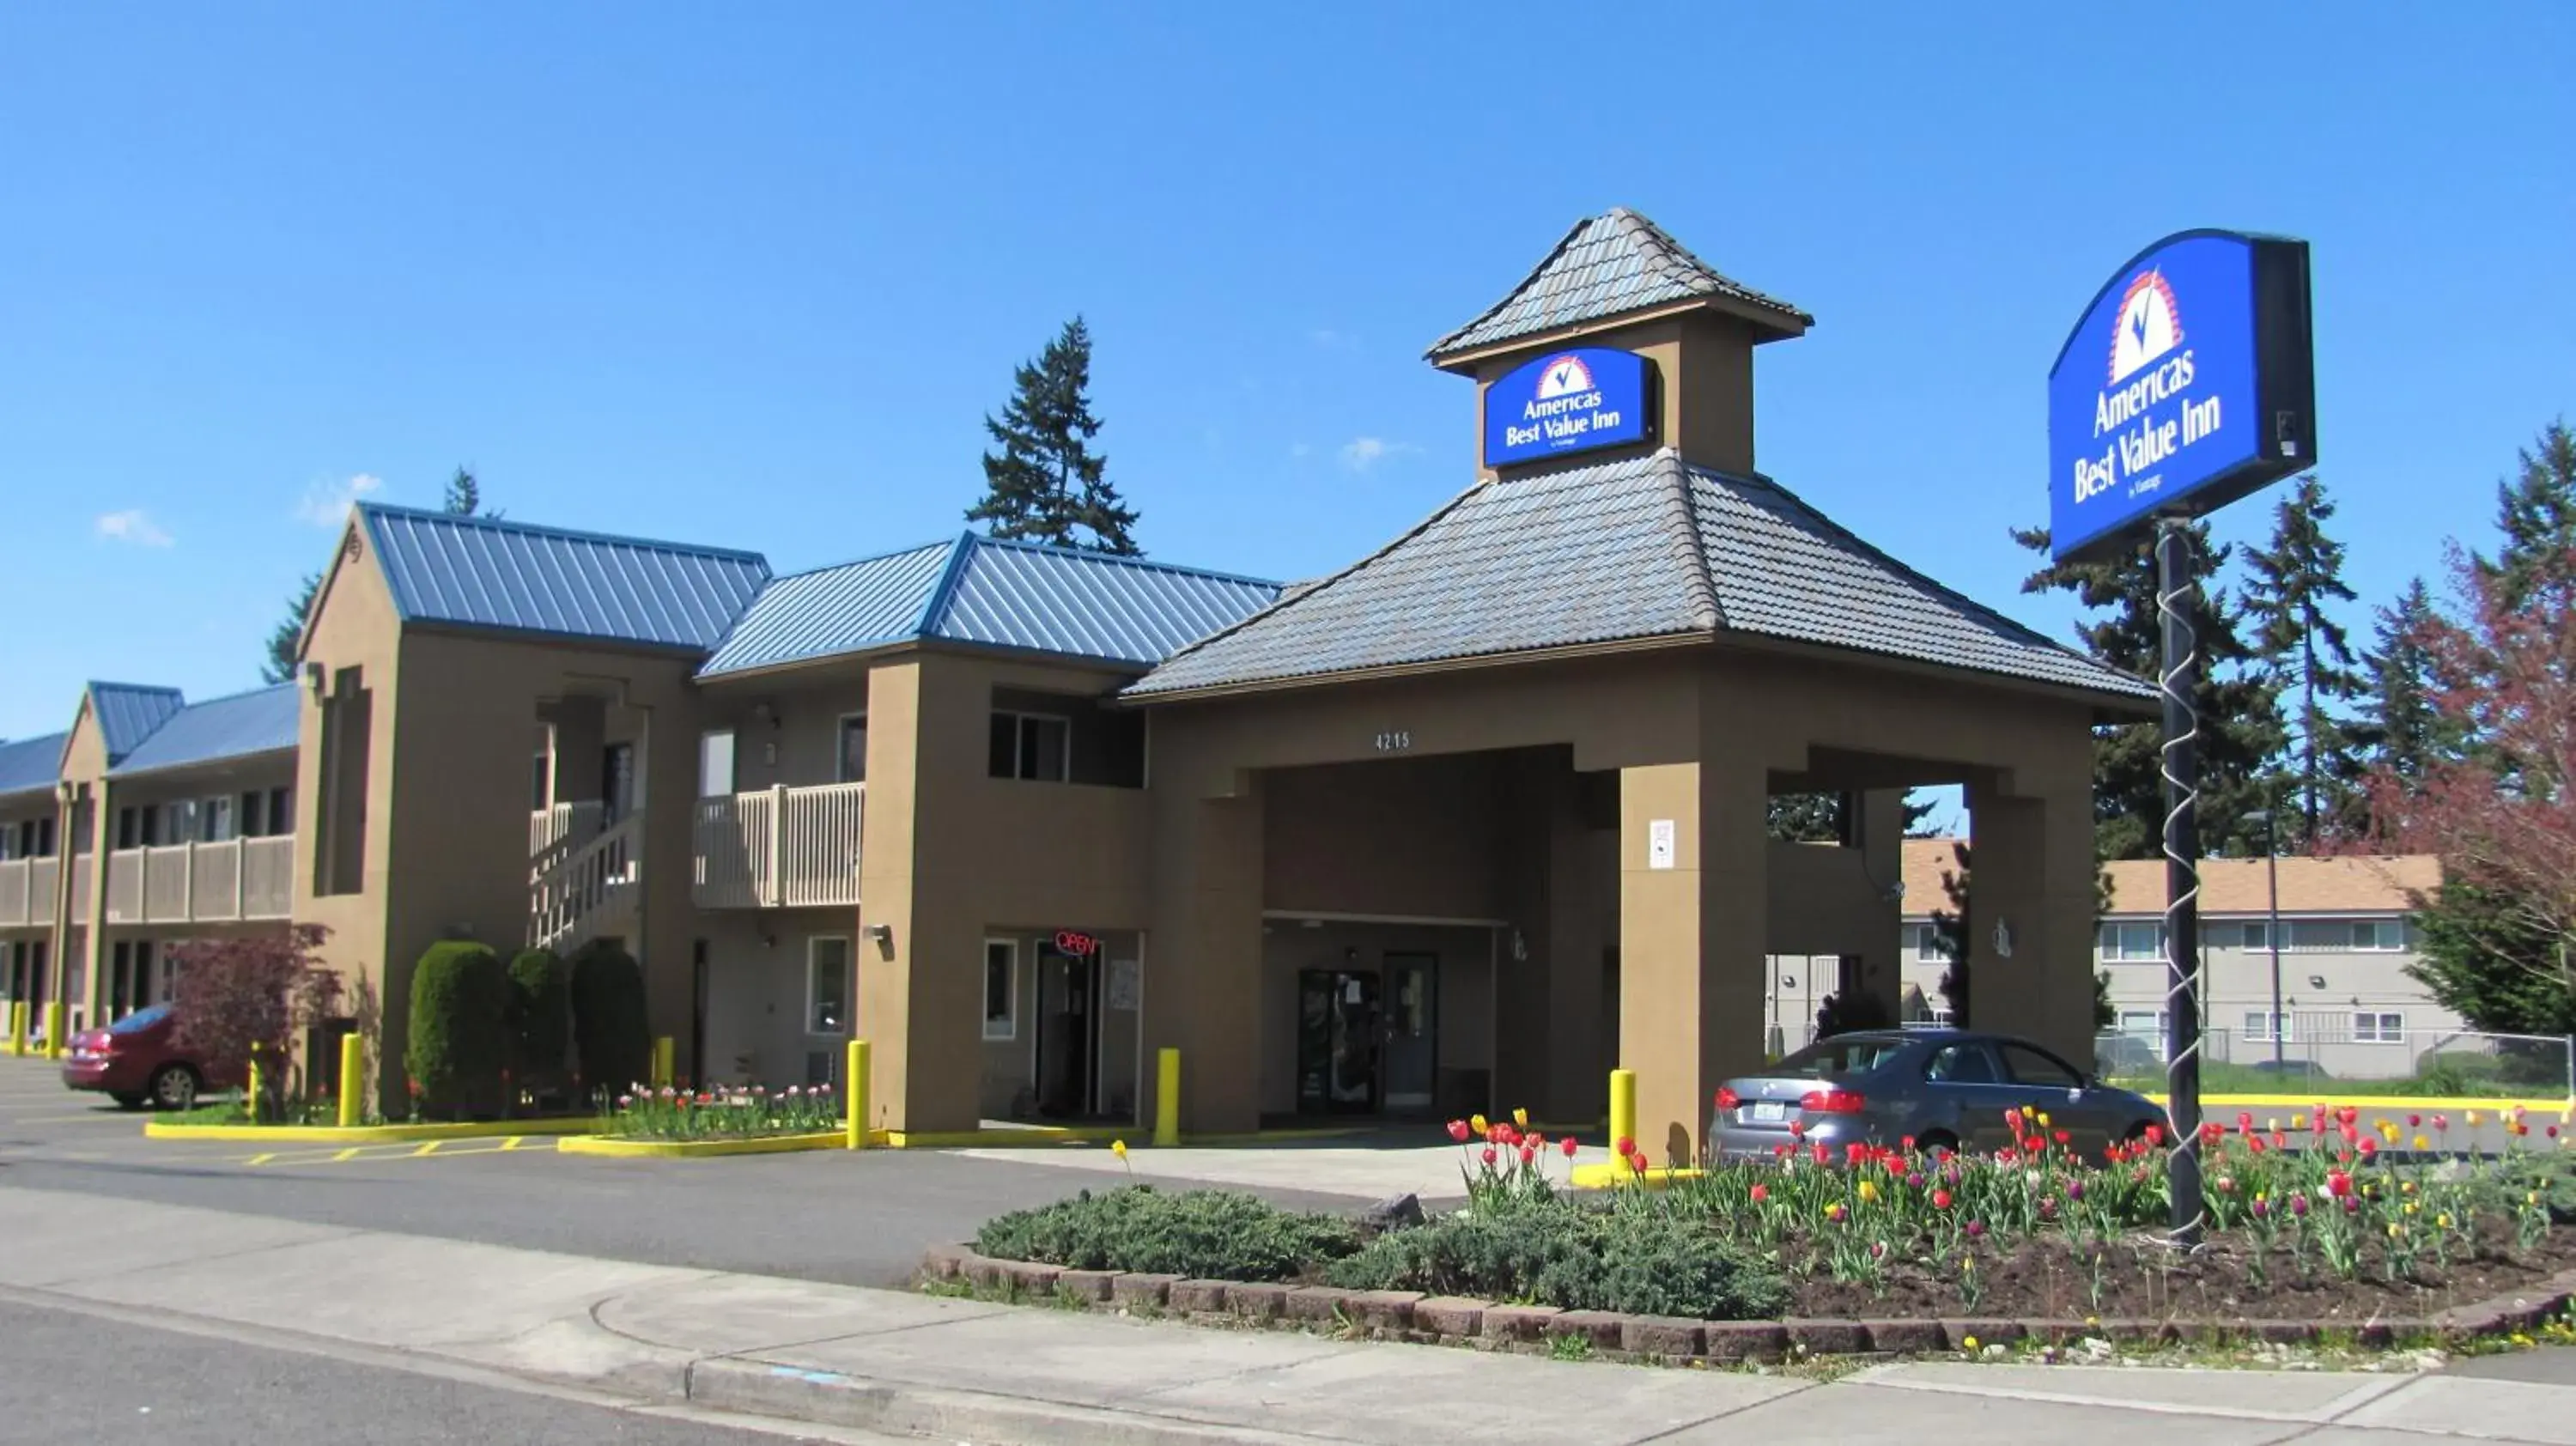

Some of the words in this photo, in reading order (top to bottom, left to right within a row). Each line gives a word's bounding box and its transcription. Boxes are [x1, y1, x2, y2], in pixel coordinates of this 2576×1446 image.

[1523, 392, 1601, 421] Americas
[2094, 349, 2194, 439] Americas
[1506, 423, 1540, 447] Best
[1544, 414, 1589, 439] Value
[1593, 410, 1620, 429] Inn
[2075, 444, 2116, 504] Best
[2119, 416, 2177, 477] Value
[2182, 396, 2221, 446] Inn
[1376, 732, 1409, 750] 4215
[1056, 932, 1095, 955] OPEN
